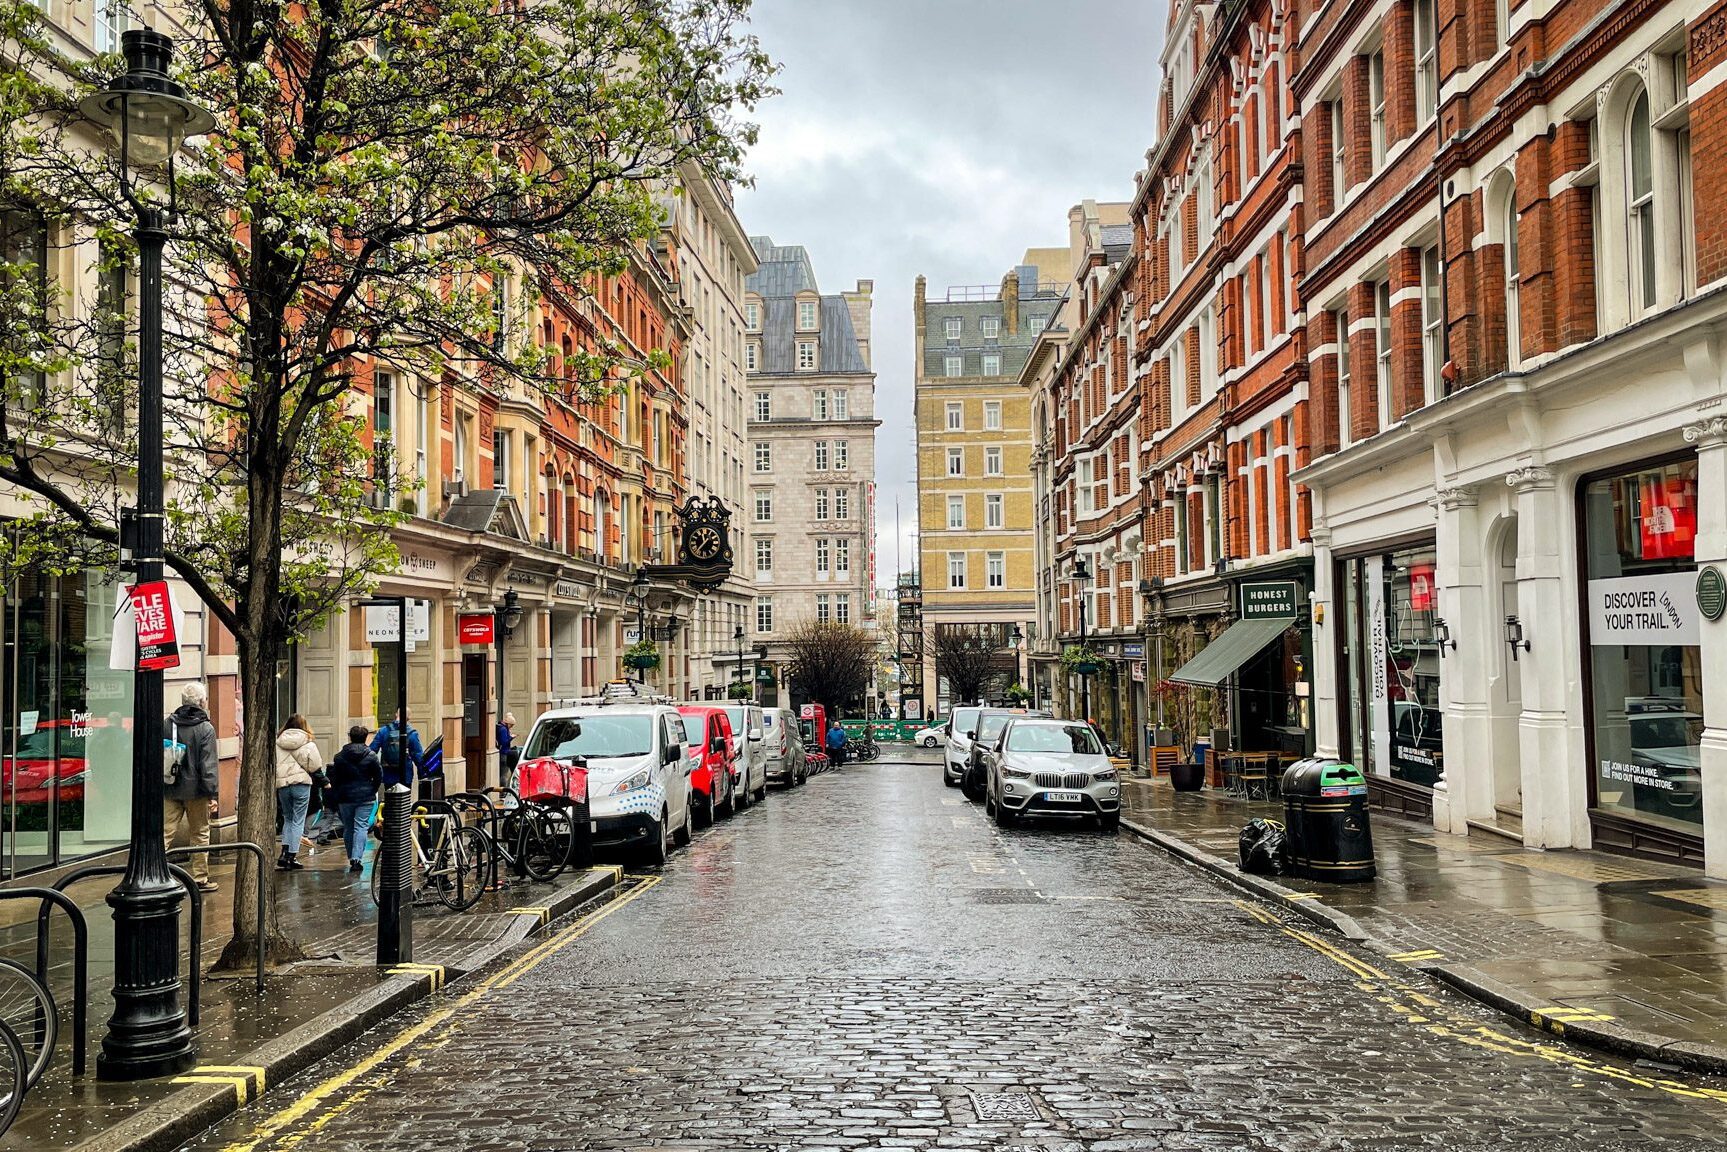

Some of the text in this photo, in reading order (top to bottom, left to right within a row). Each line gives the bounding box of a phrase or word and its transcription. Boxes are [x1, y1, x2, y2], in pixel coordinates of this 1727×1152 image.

[1250, 590, 1288, 600] HONEST
[1248, 603, 1292, 613] BURGERS
[1604, 591, 1656, 610] DISCOVER
[1660, 590, 1683, 630] LONDON
[1604, 612, 1670, 630] YOUR TRAIL.
[70, 708, 93, 723] Tower
[70, 724, 94, 738] House
[1612, 762, 1622, 771] JOIN
[1623, 764, 1630, 772] US
[1630, 764, 1640, 774] FOR
[1641, 766, 1645, 776] A
[1612, 771, 1622, 780] FIND
[1623, 773, 1633, 782] OUT
[1634, 775, 1648, 786] MORE
[1649, 778, 1654, 786] IN
